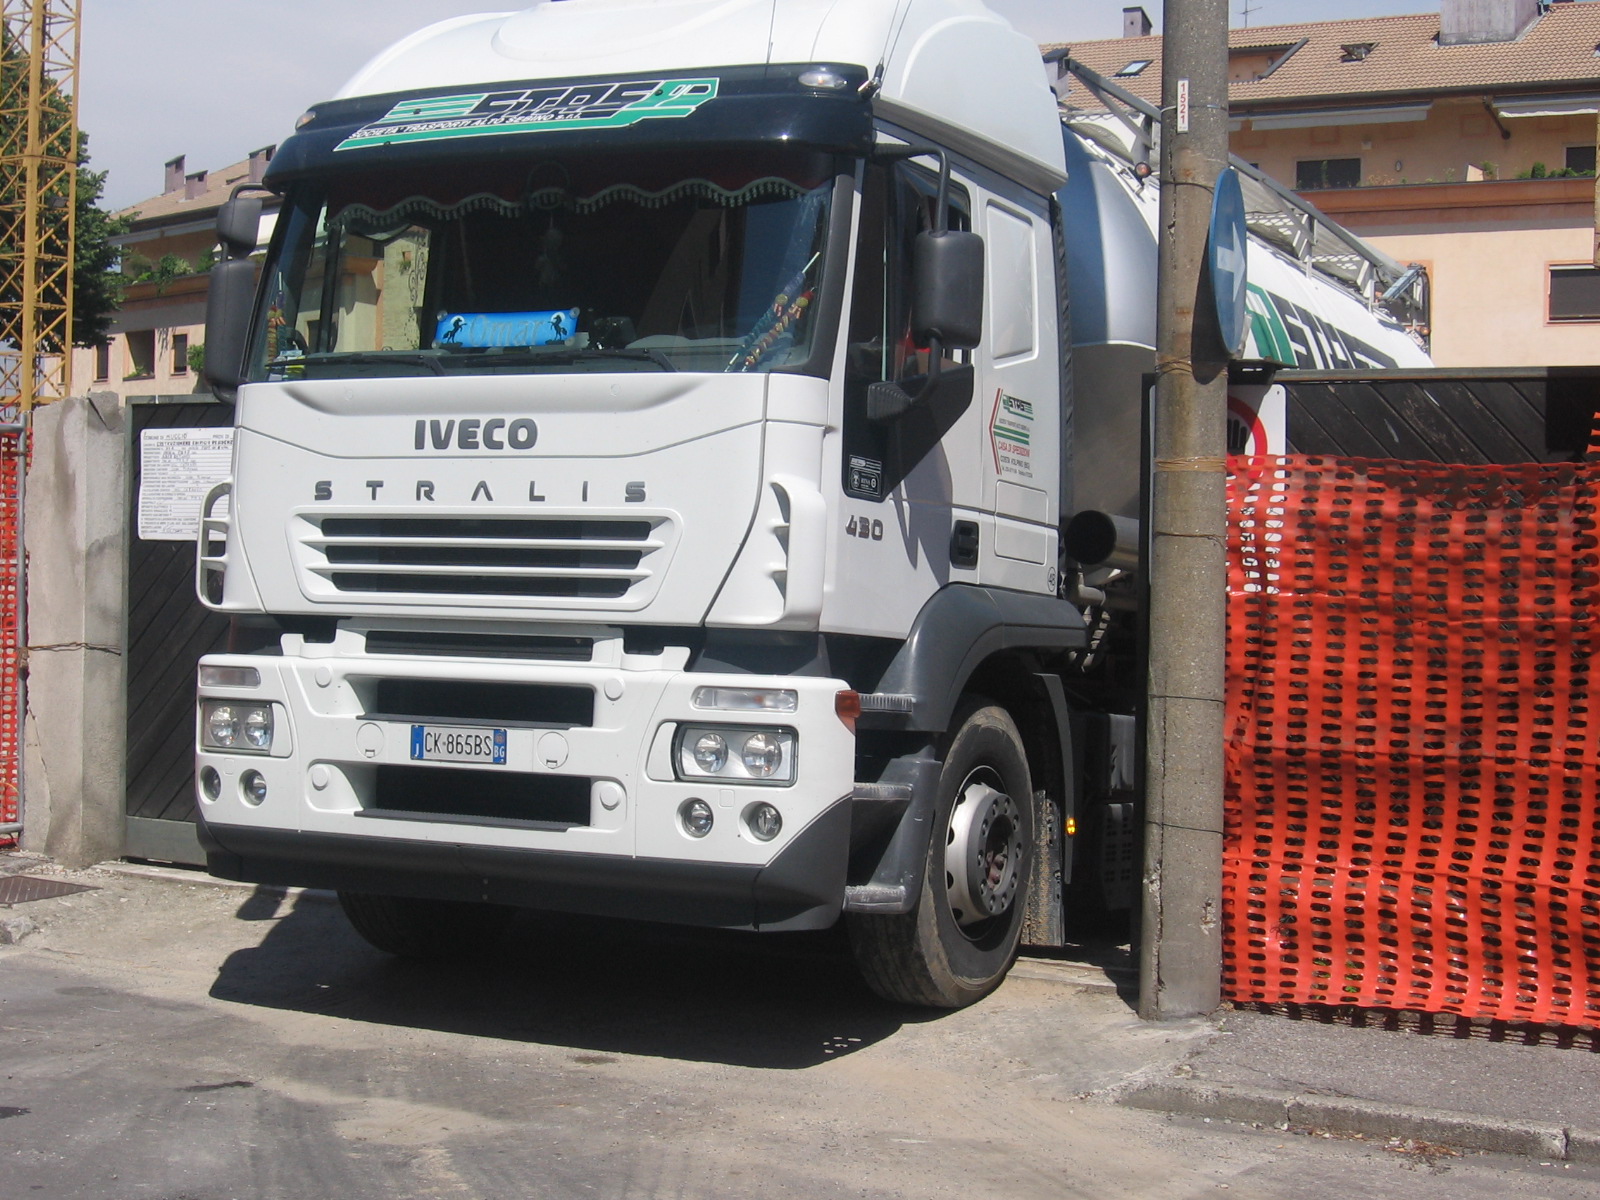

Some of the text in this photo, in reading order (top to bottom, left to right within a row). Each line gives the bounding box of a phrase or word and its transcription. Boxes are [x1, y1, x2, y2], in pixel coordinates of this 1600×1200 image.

[403, 119, 468, 133] TRASPORTI
[469, 314, 545, 347] Omar
[414, 418, 538, 450] IVECO
[314, 480, 647, 502] STRALIS
[845, 515, 883, 541] 430
[494, 745, 505, 758] BG
